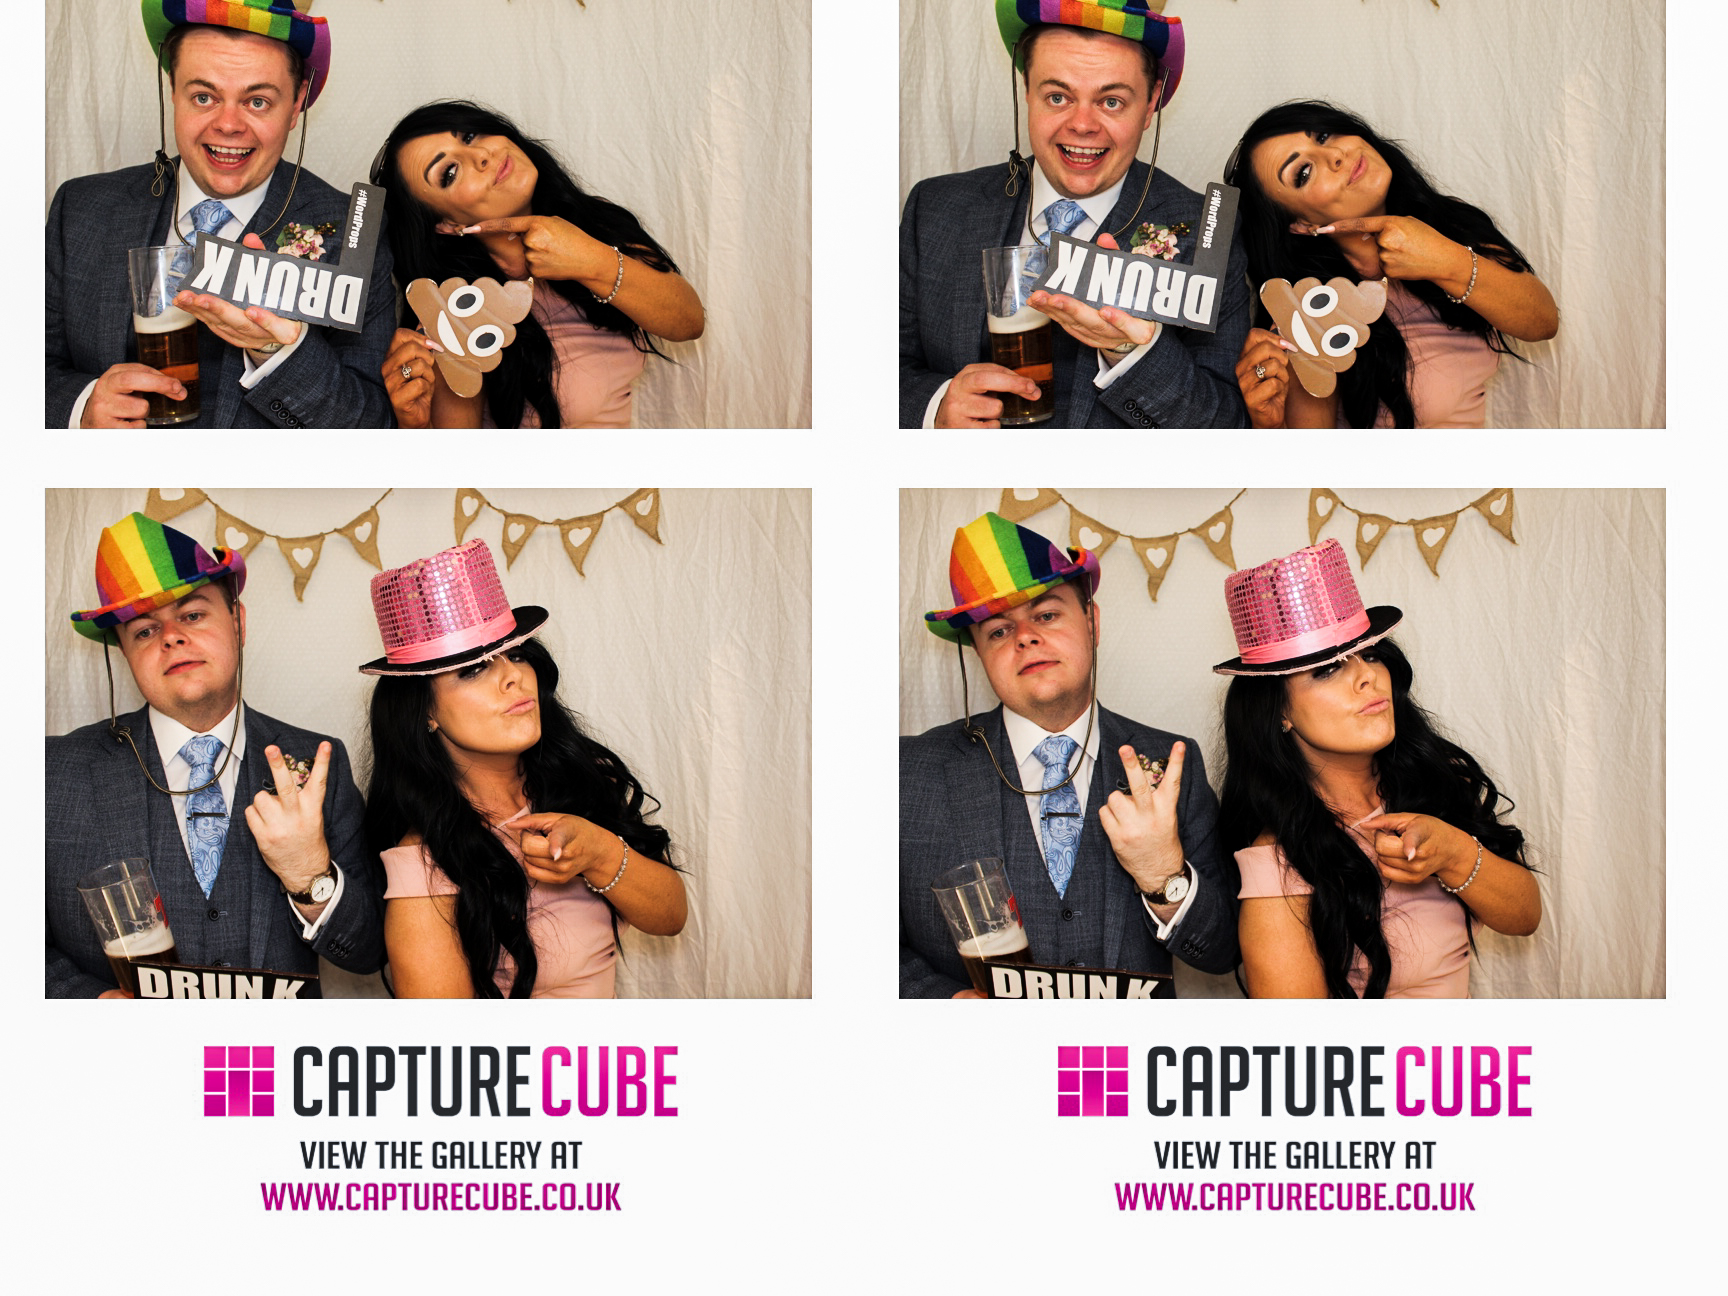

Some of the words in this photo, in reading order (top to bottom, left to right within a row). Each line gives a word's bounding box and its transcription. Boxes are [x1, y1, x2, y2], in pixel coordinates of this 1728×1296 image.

[348, 189, 368, 249] #WordProps
[1202, 189, 1222, 249] #WordProps
[190, 240, 364, 325] DRUNK
[1044, 240, 1218, 325] DRUNK
[137, 966, 305, 999] DRUNK
[991, 966, 1159, 999] DRUNK
